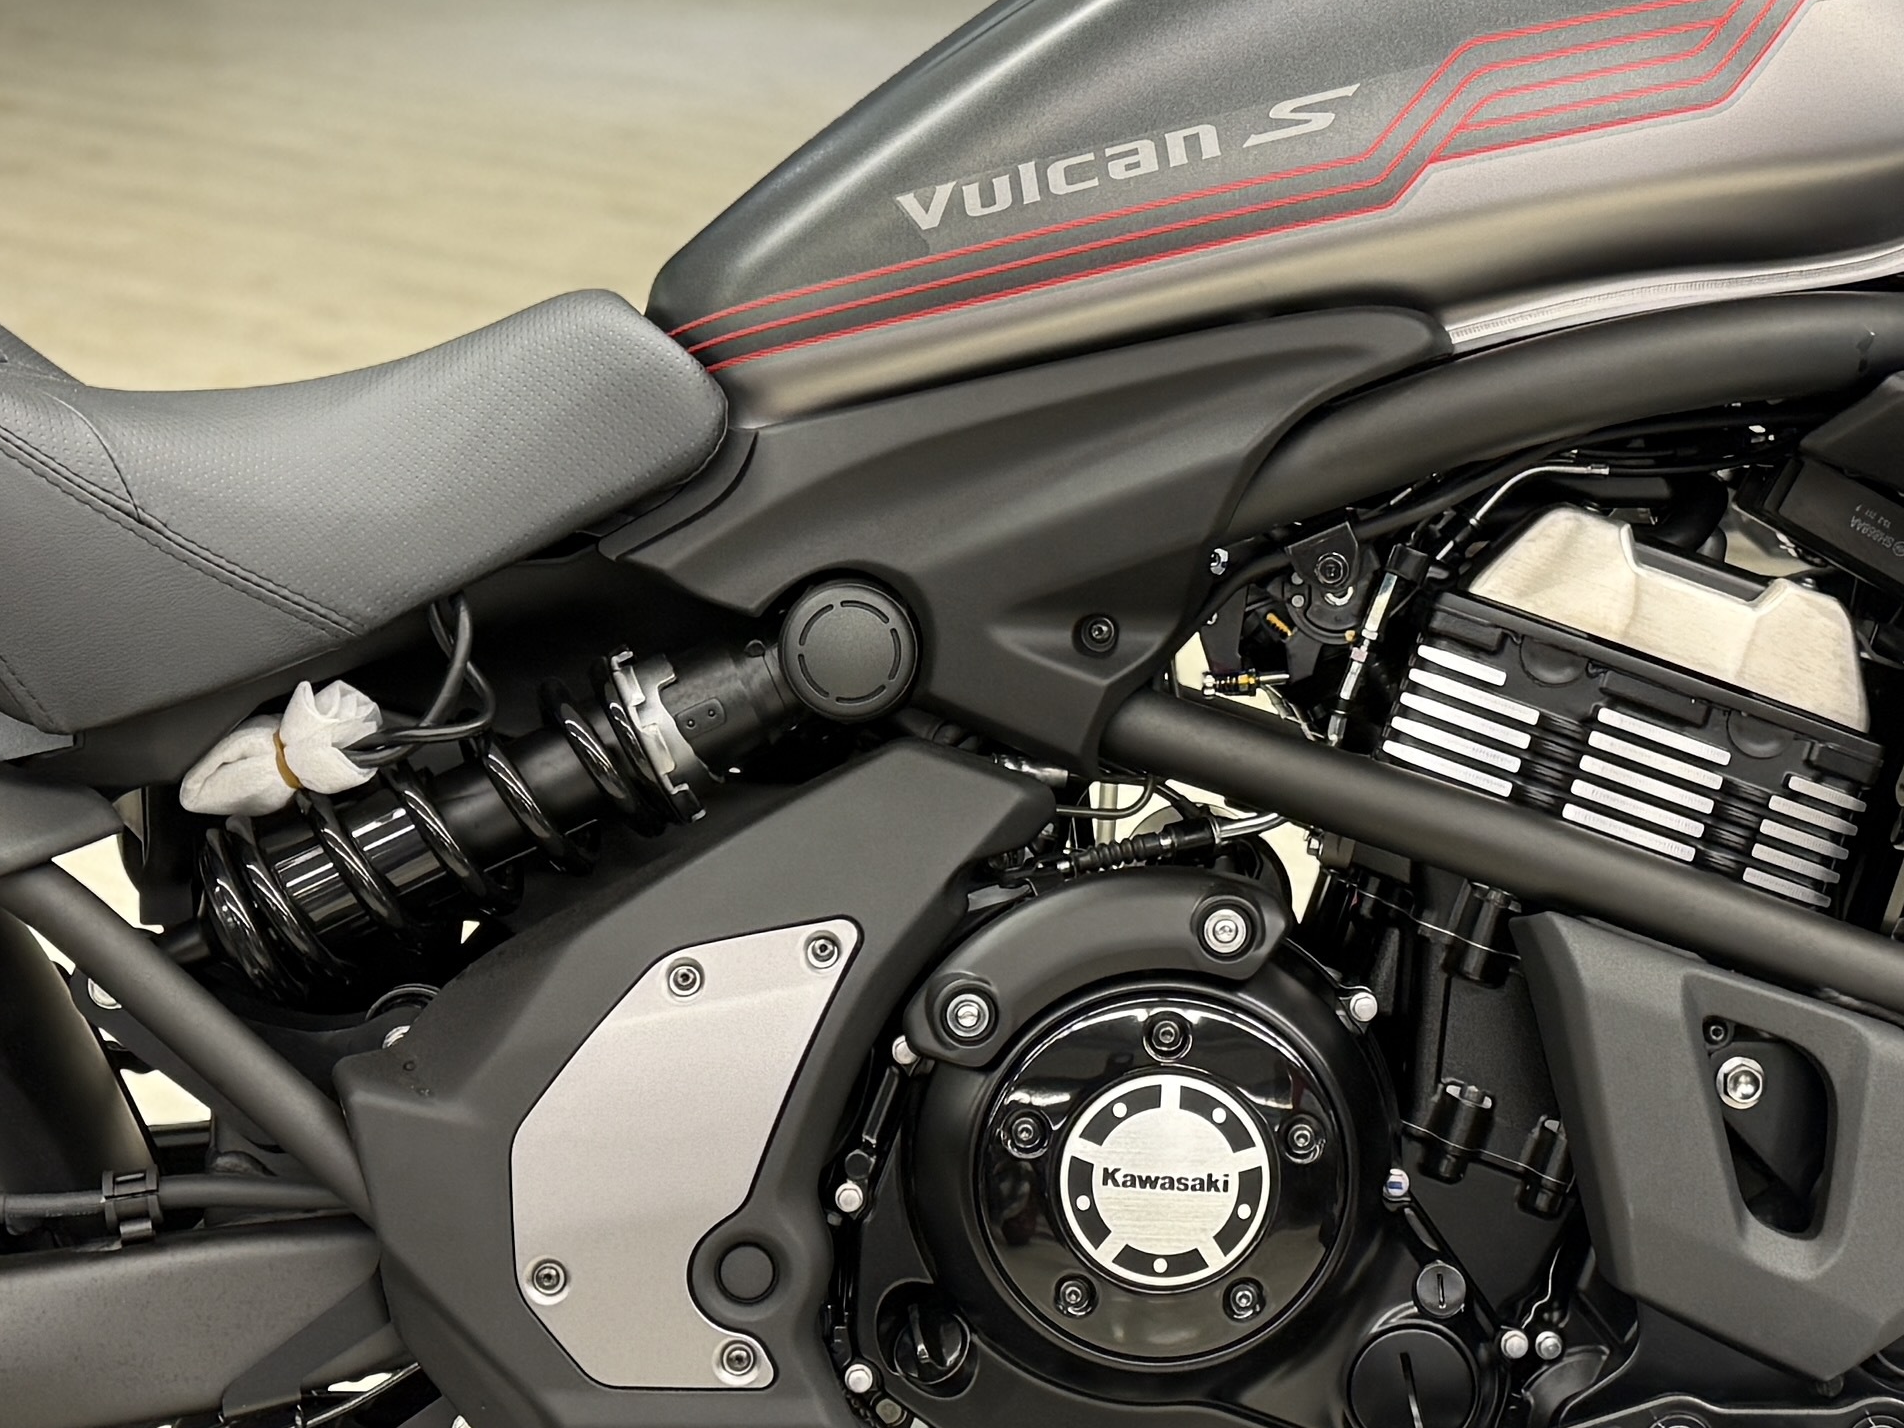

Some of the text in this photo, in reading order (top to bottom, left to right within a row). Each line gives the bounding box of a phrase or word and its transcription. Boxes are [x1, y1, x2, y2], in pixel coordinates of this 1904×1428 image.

[896, 83, 1361, 231] Vulcan S
[1101, 1166, 1230, 1194] Kawasaki
